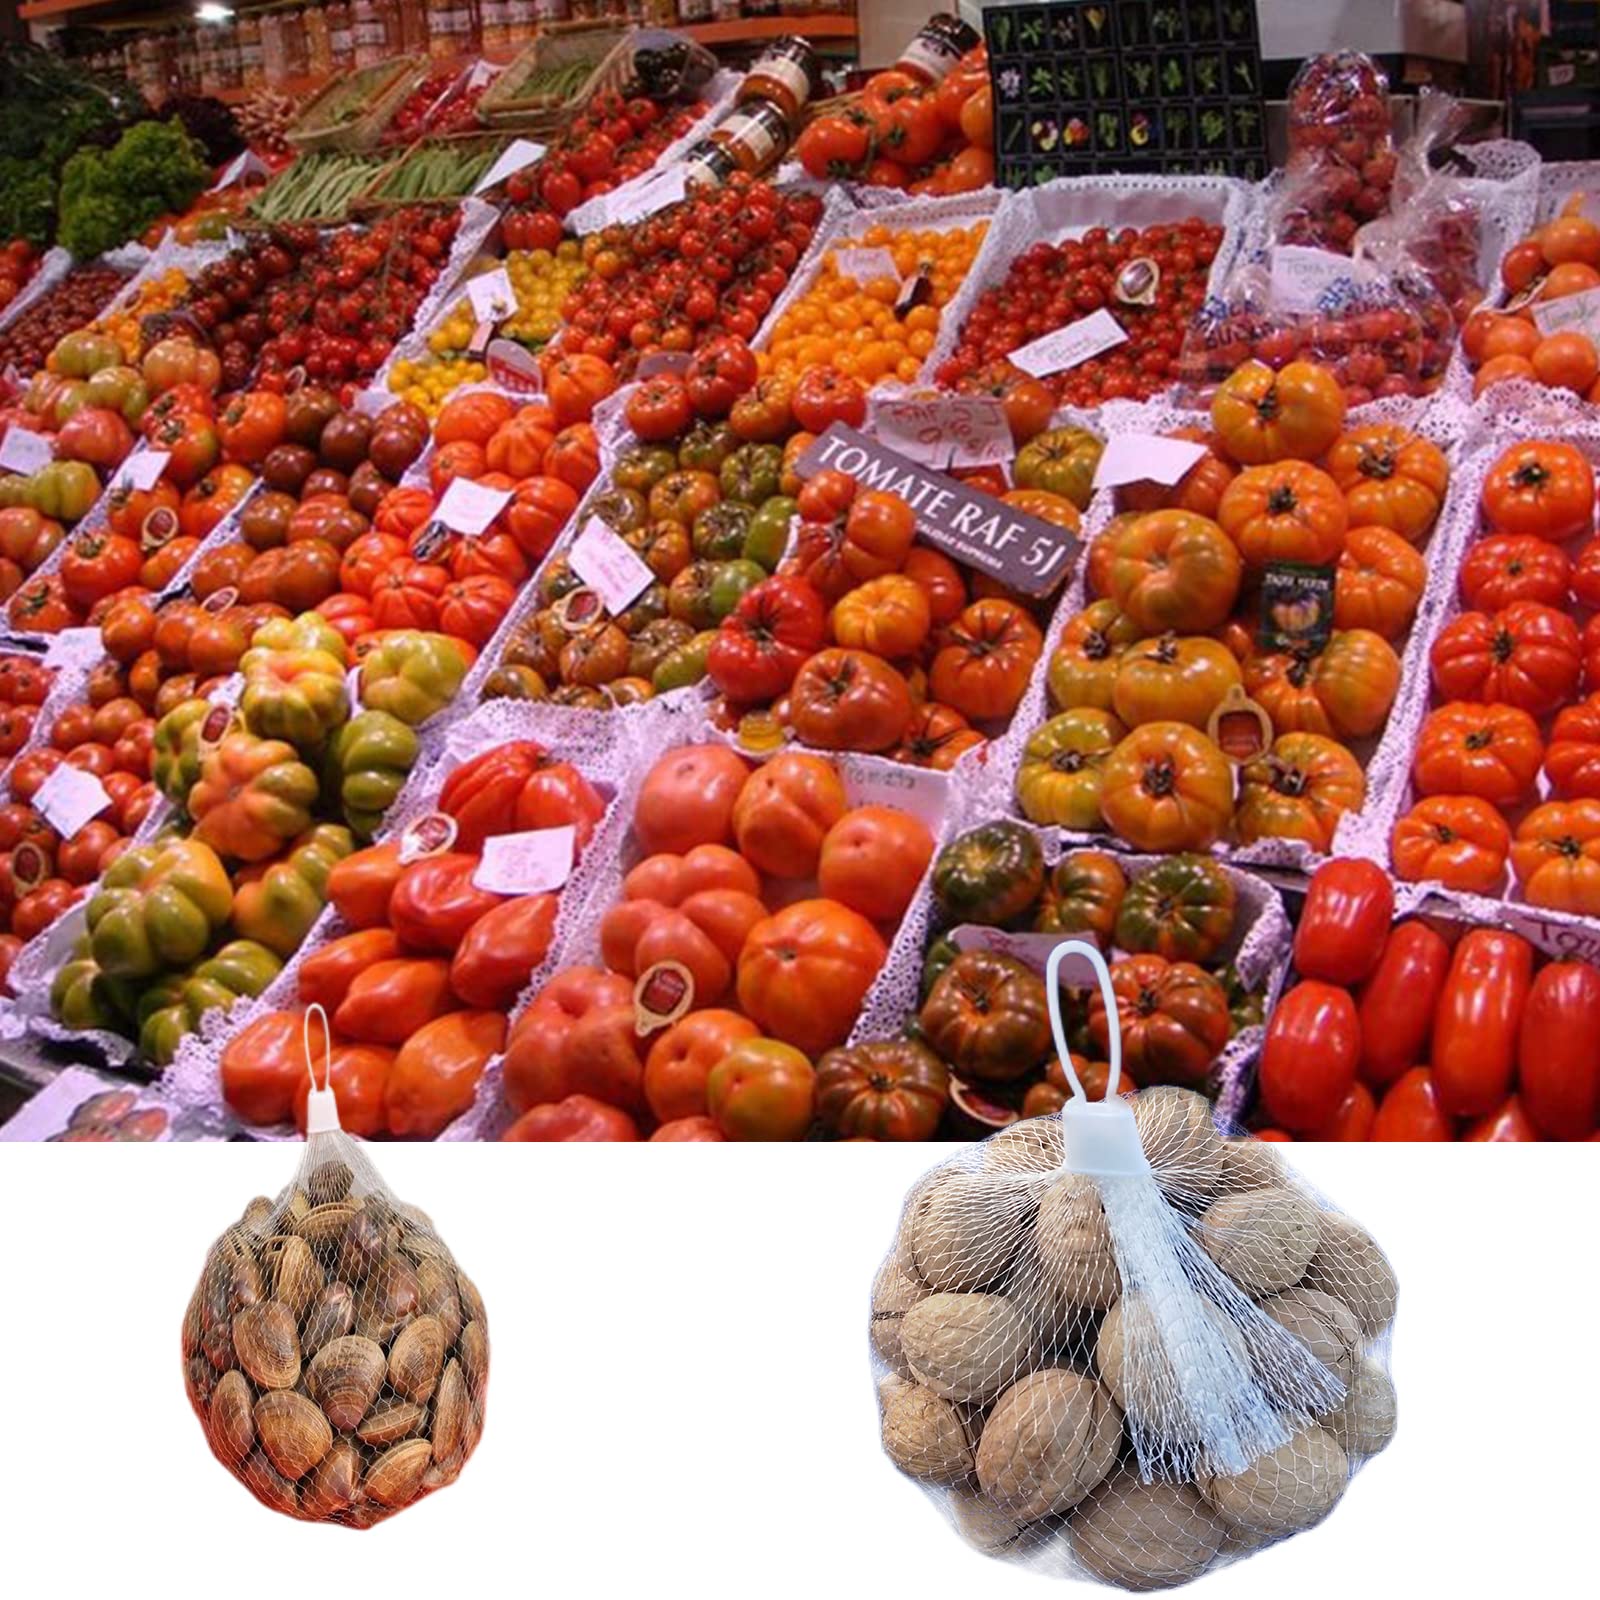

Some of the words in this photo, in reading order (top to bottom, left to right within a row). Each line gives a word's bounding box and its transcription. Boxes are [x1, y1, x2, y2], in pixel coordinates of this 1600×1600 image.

[818, 435, 955, 519] TOMATE
[949, 501, 1026, 550] RAF
[1020, 538, 1066, 576] 5J
